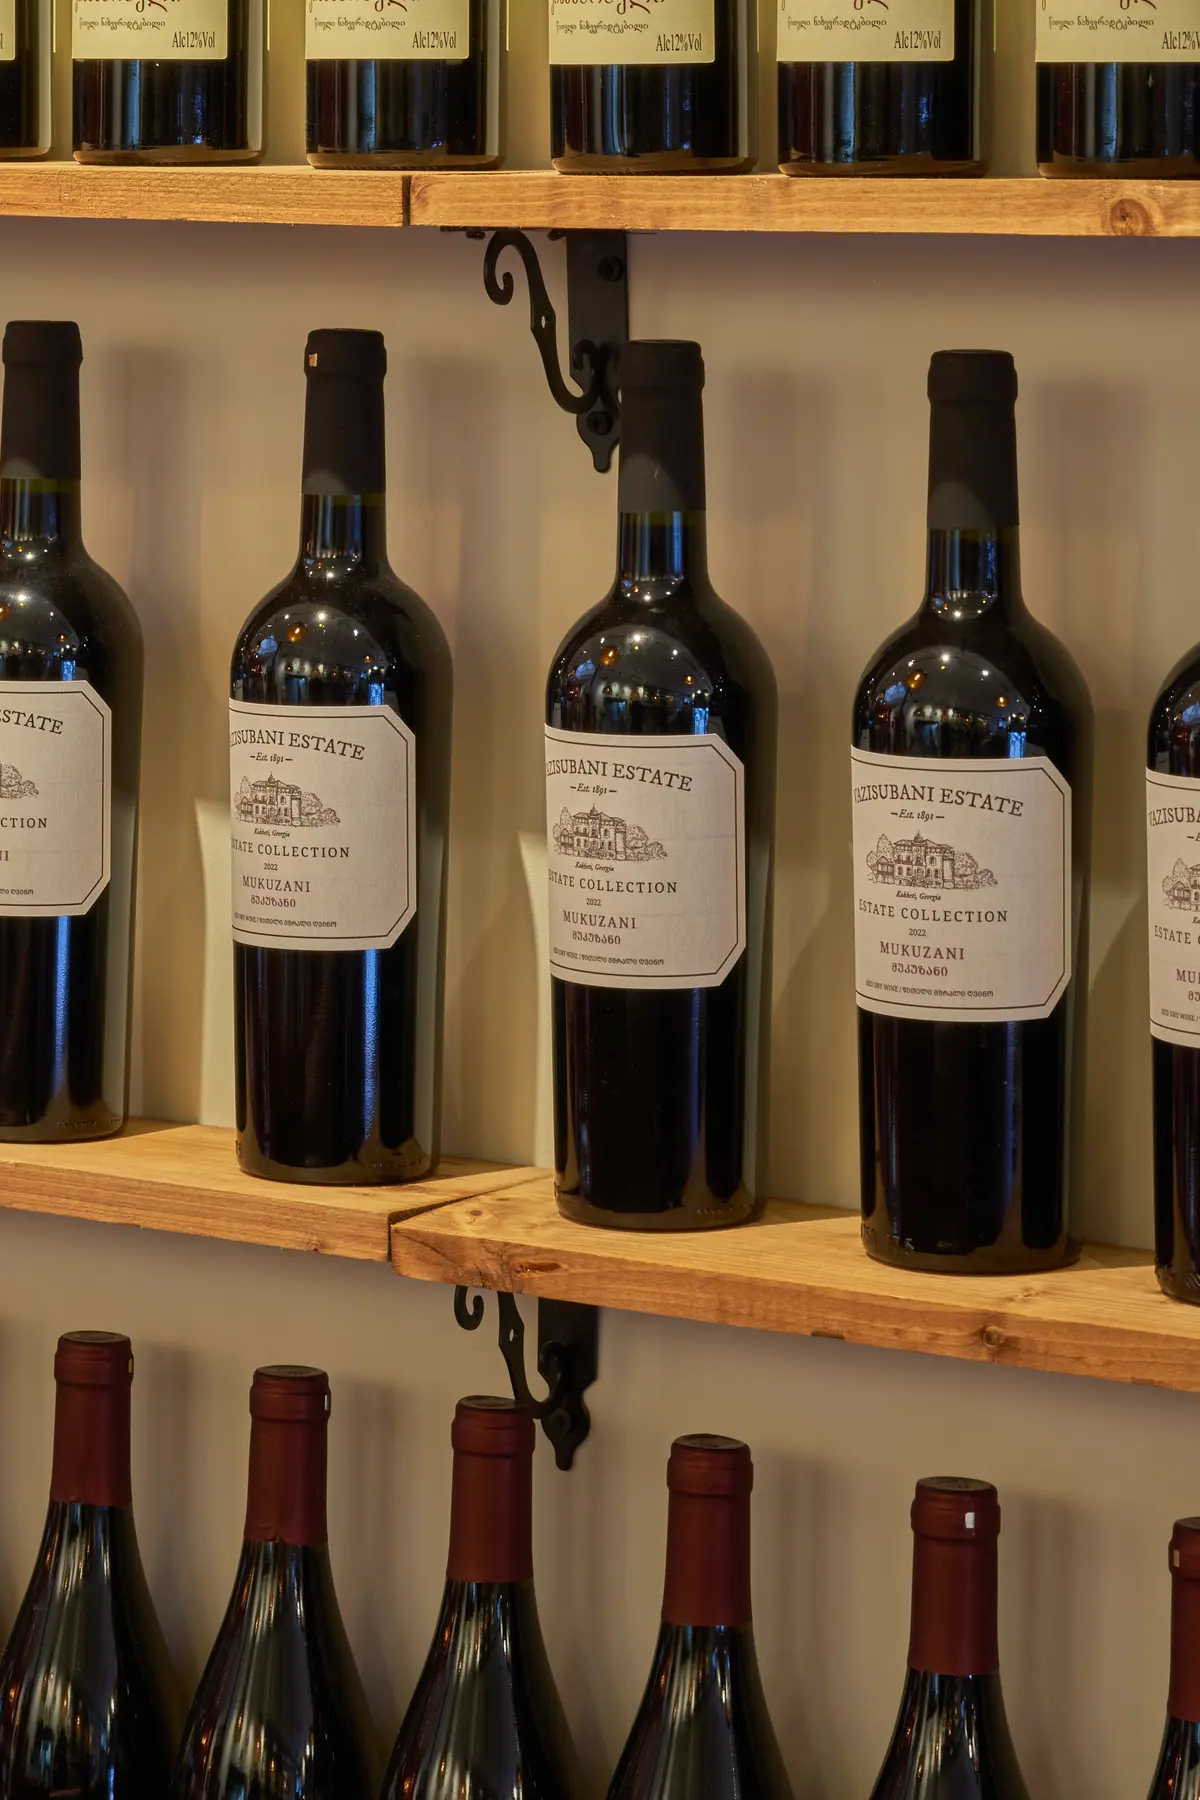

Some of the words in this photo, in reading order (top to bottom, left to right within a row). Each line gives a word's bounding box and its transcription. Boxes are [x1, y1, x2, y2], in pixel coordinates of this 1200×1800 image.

[288, 732, 366, 760] ESTATE
[612, 763, 693, 792] ESTATE
[940, 787, 1023, 817] ESTATE
[257, 843, 350, 858] COLLECTION
[242, 875, 311, 893] MUKUZANI
[579, 878, 678, 893] COLLECTION
[563, 910, 636, 929] MUKUZANI
[859, 898, 895, 918] ESTATE
[901, 908, 1008, 923] COLLECTION
[908, 928, 927, 937] 2022
[880, 941, 965, 960] MUKUZANI
